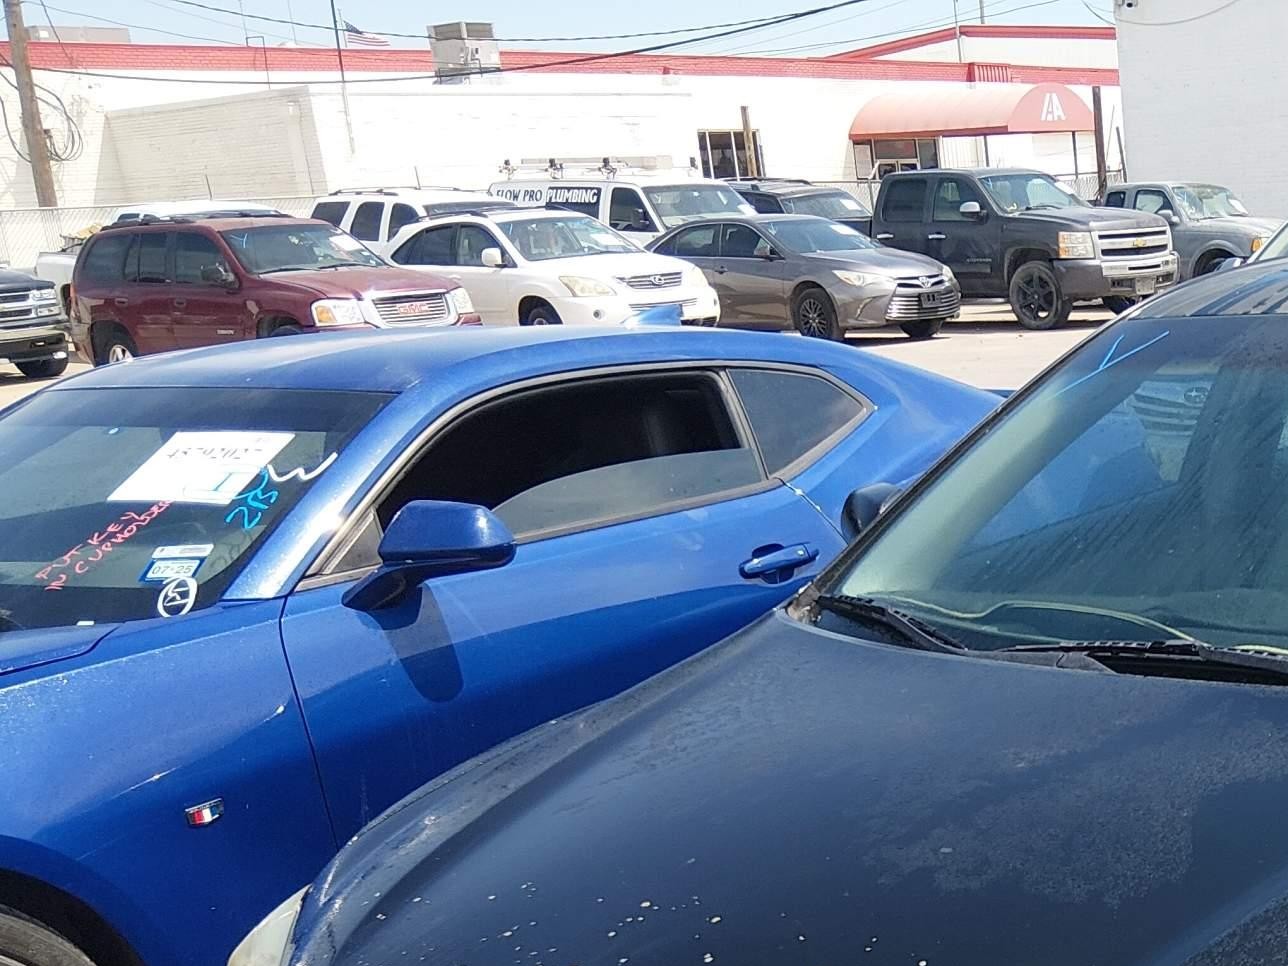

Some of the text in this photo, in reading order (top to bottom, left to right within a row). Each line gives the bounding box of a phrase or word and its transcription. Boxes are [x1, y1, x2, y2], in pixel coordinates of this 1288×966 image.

[523, 189, 543, 202] PRO
[546, 188, 598, 204] PLUMBING
[397, 303, 428, 314] GMC
